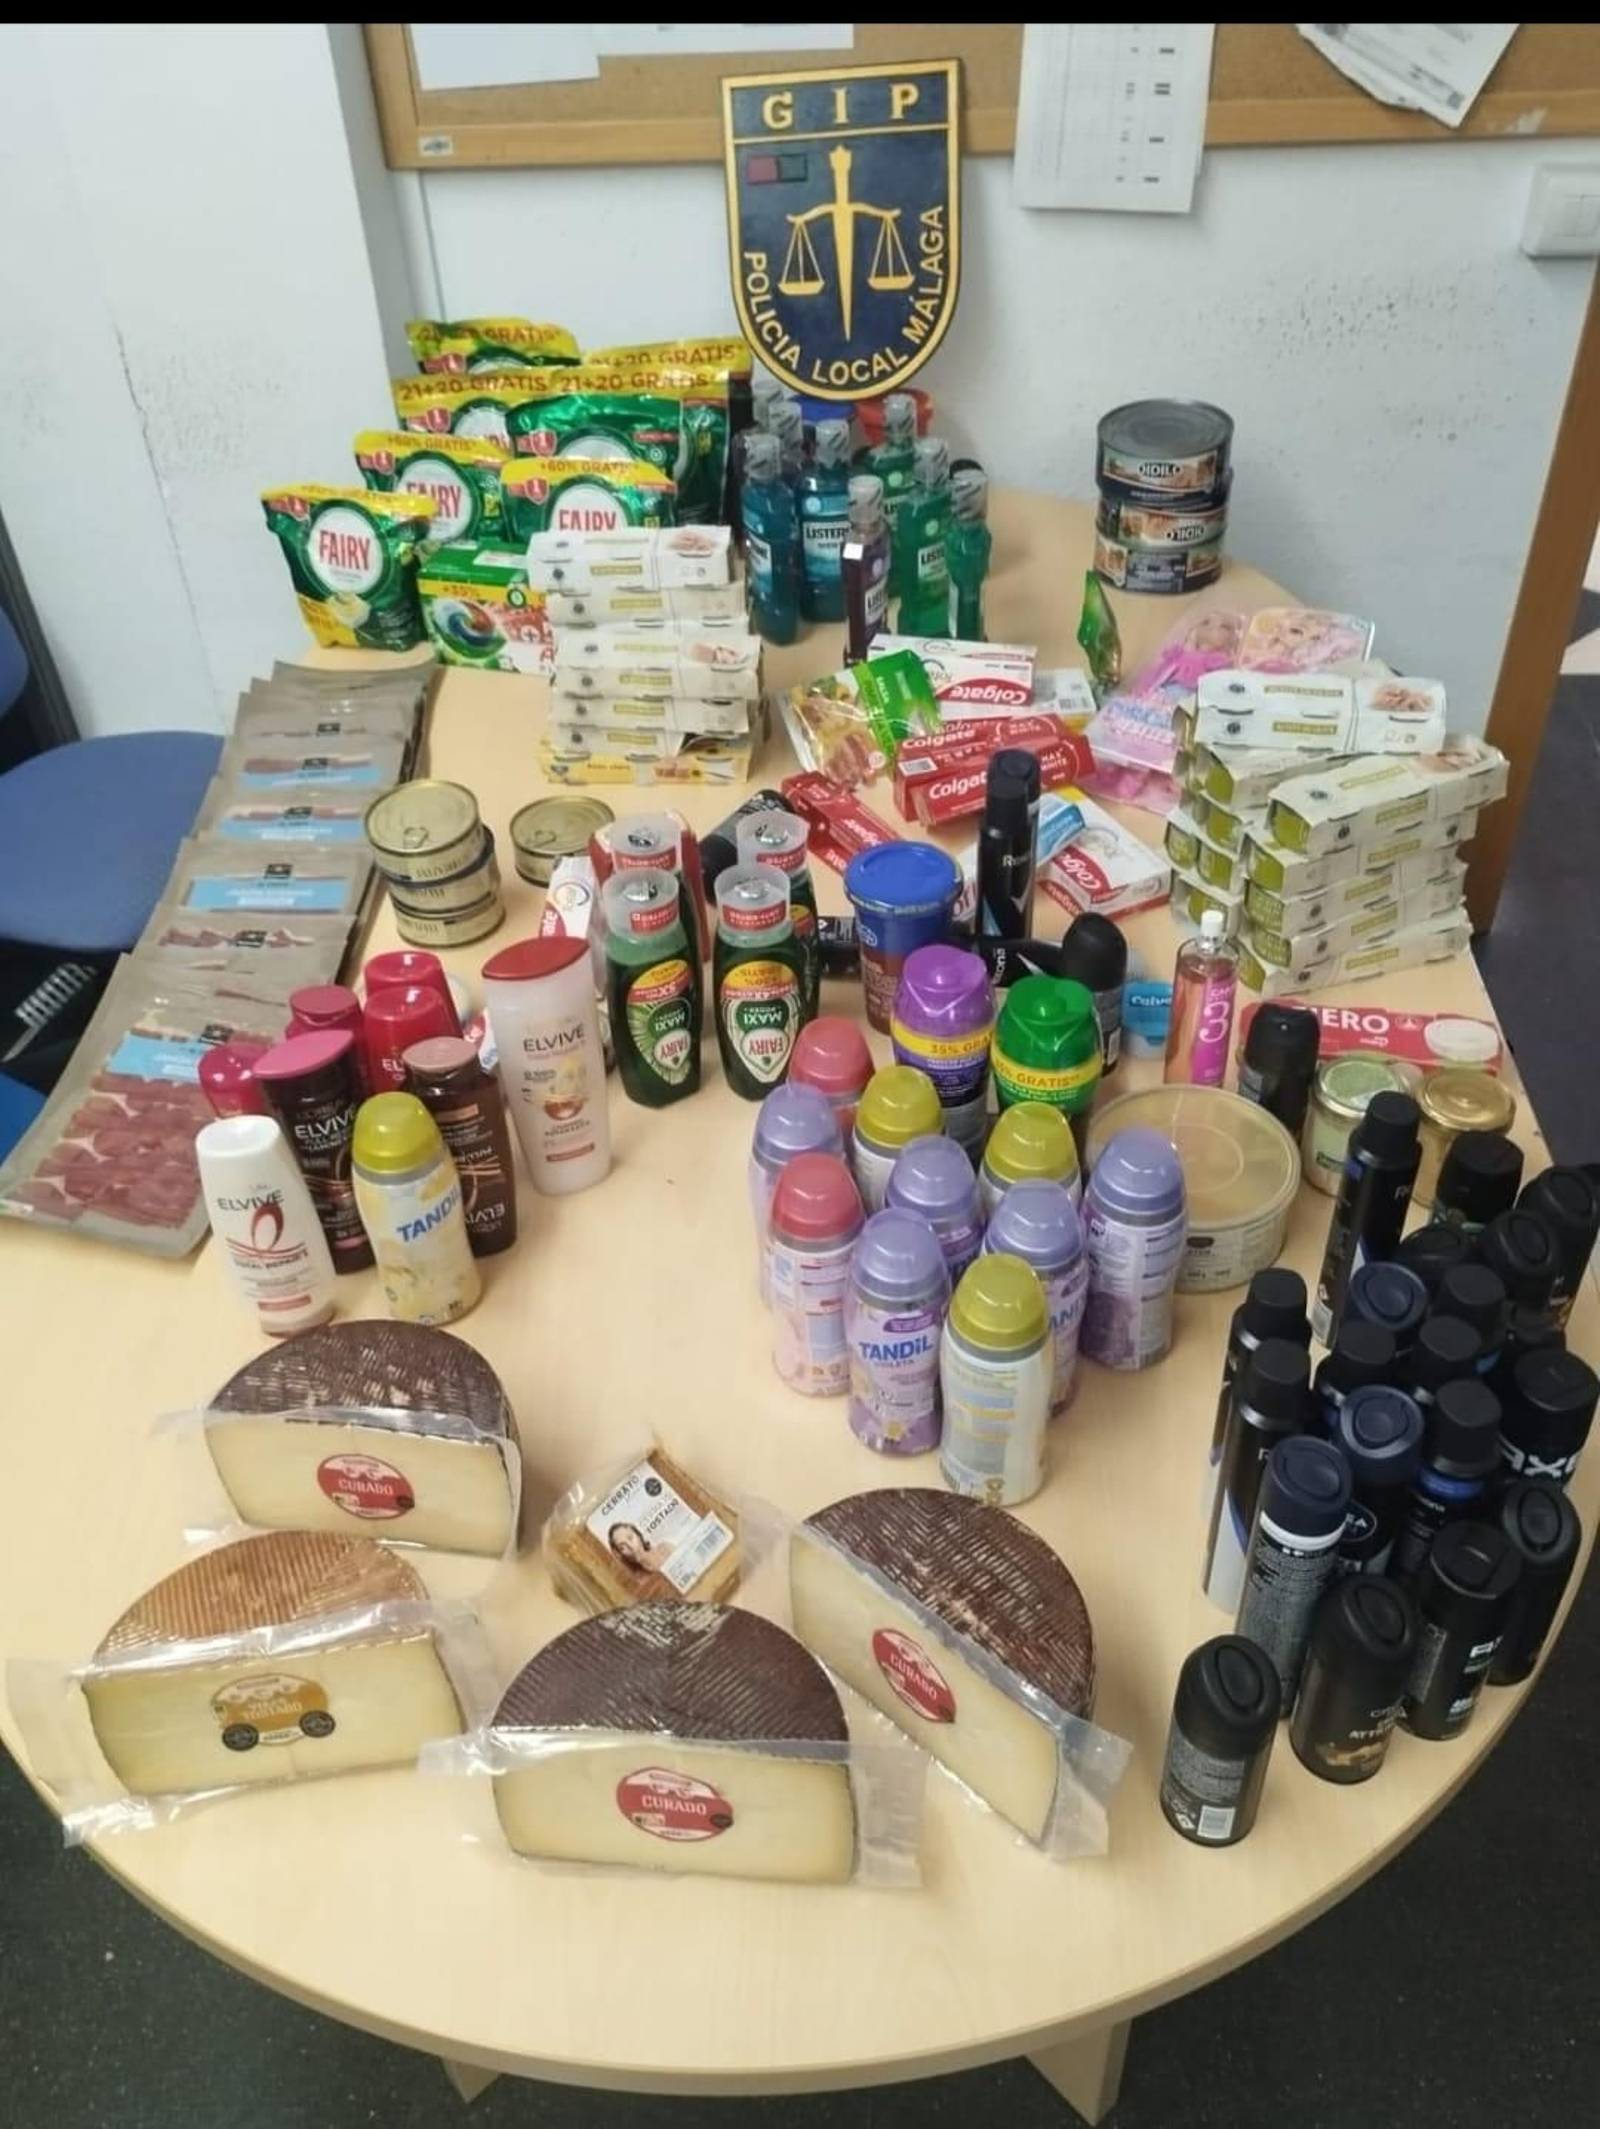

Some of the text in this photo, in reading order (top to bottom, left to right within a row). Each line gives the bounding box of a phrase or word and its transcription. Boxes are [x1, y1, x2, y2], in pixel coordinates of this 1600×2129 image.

[811, 346, 909, 387] LOCAL
[901, 204, 944, 343] MÁLAGA
[319, 530, 370, 570] FAIRY
[948, 686, 1028, 705] Colgate
[929, 770, 988, 800] Colgat
[743, 1011, 783, 1025] MAXI
[522, 1022, 586, 1053] ELVIVE
[748, 1038, 784, 1056] FAIRY
[217, 1189, 284, 1212] ELVIVE
[601, 1474, 640, 1517] CERRATO
[641, 1795, 708, 1816] CURADO
